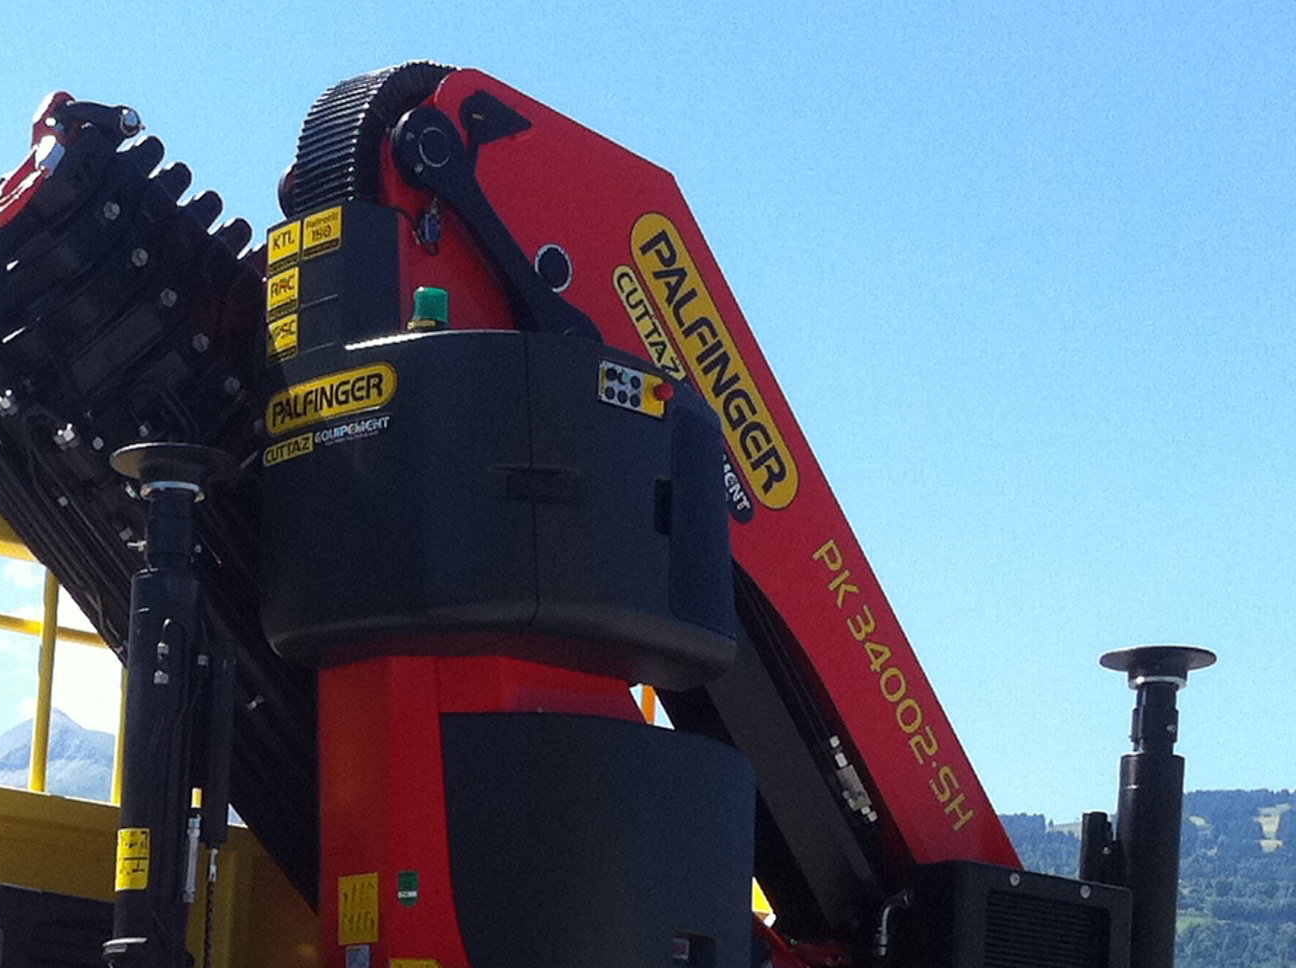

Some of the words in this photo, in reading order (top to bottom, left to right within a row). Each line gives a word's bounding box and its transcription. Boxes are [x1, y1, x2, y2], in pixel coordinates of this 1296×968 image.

[272, 229, 295, 250] KTL
[616, 271, 682, 376] CUTTAZ
[639, 229, 787, 495] PALFINGER
[272, 372, 384, 428] PALFINGER
[264, 436, 311, 464] CUTTAZ
[812, 539, 860, 608] PK
